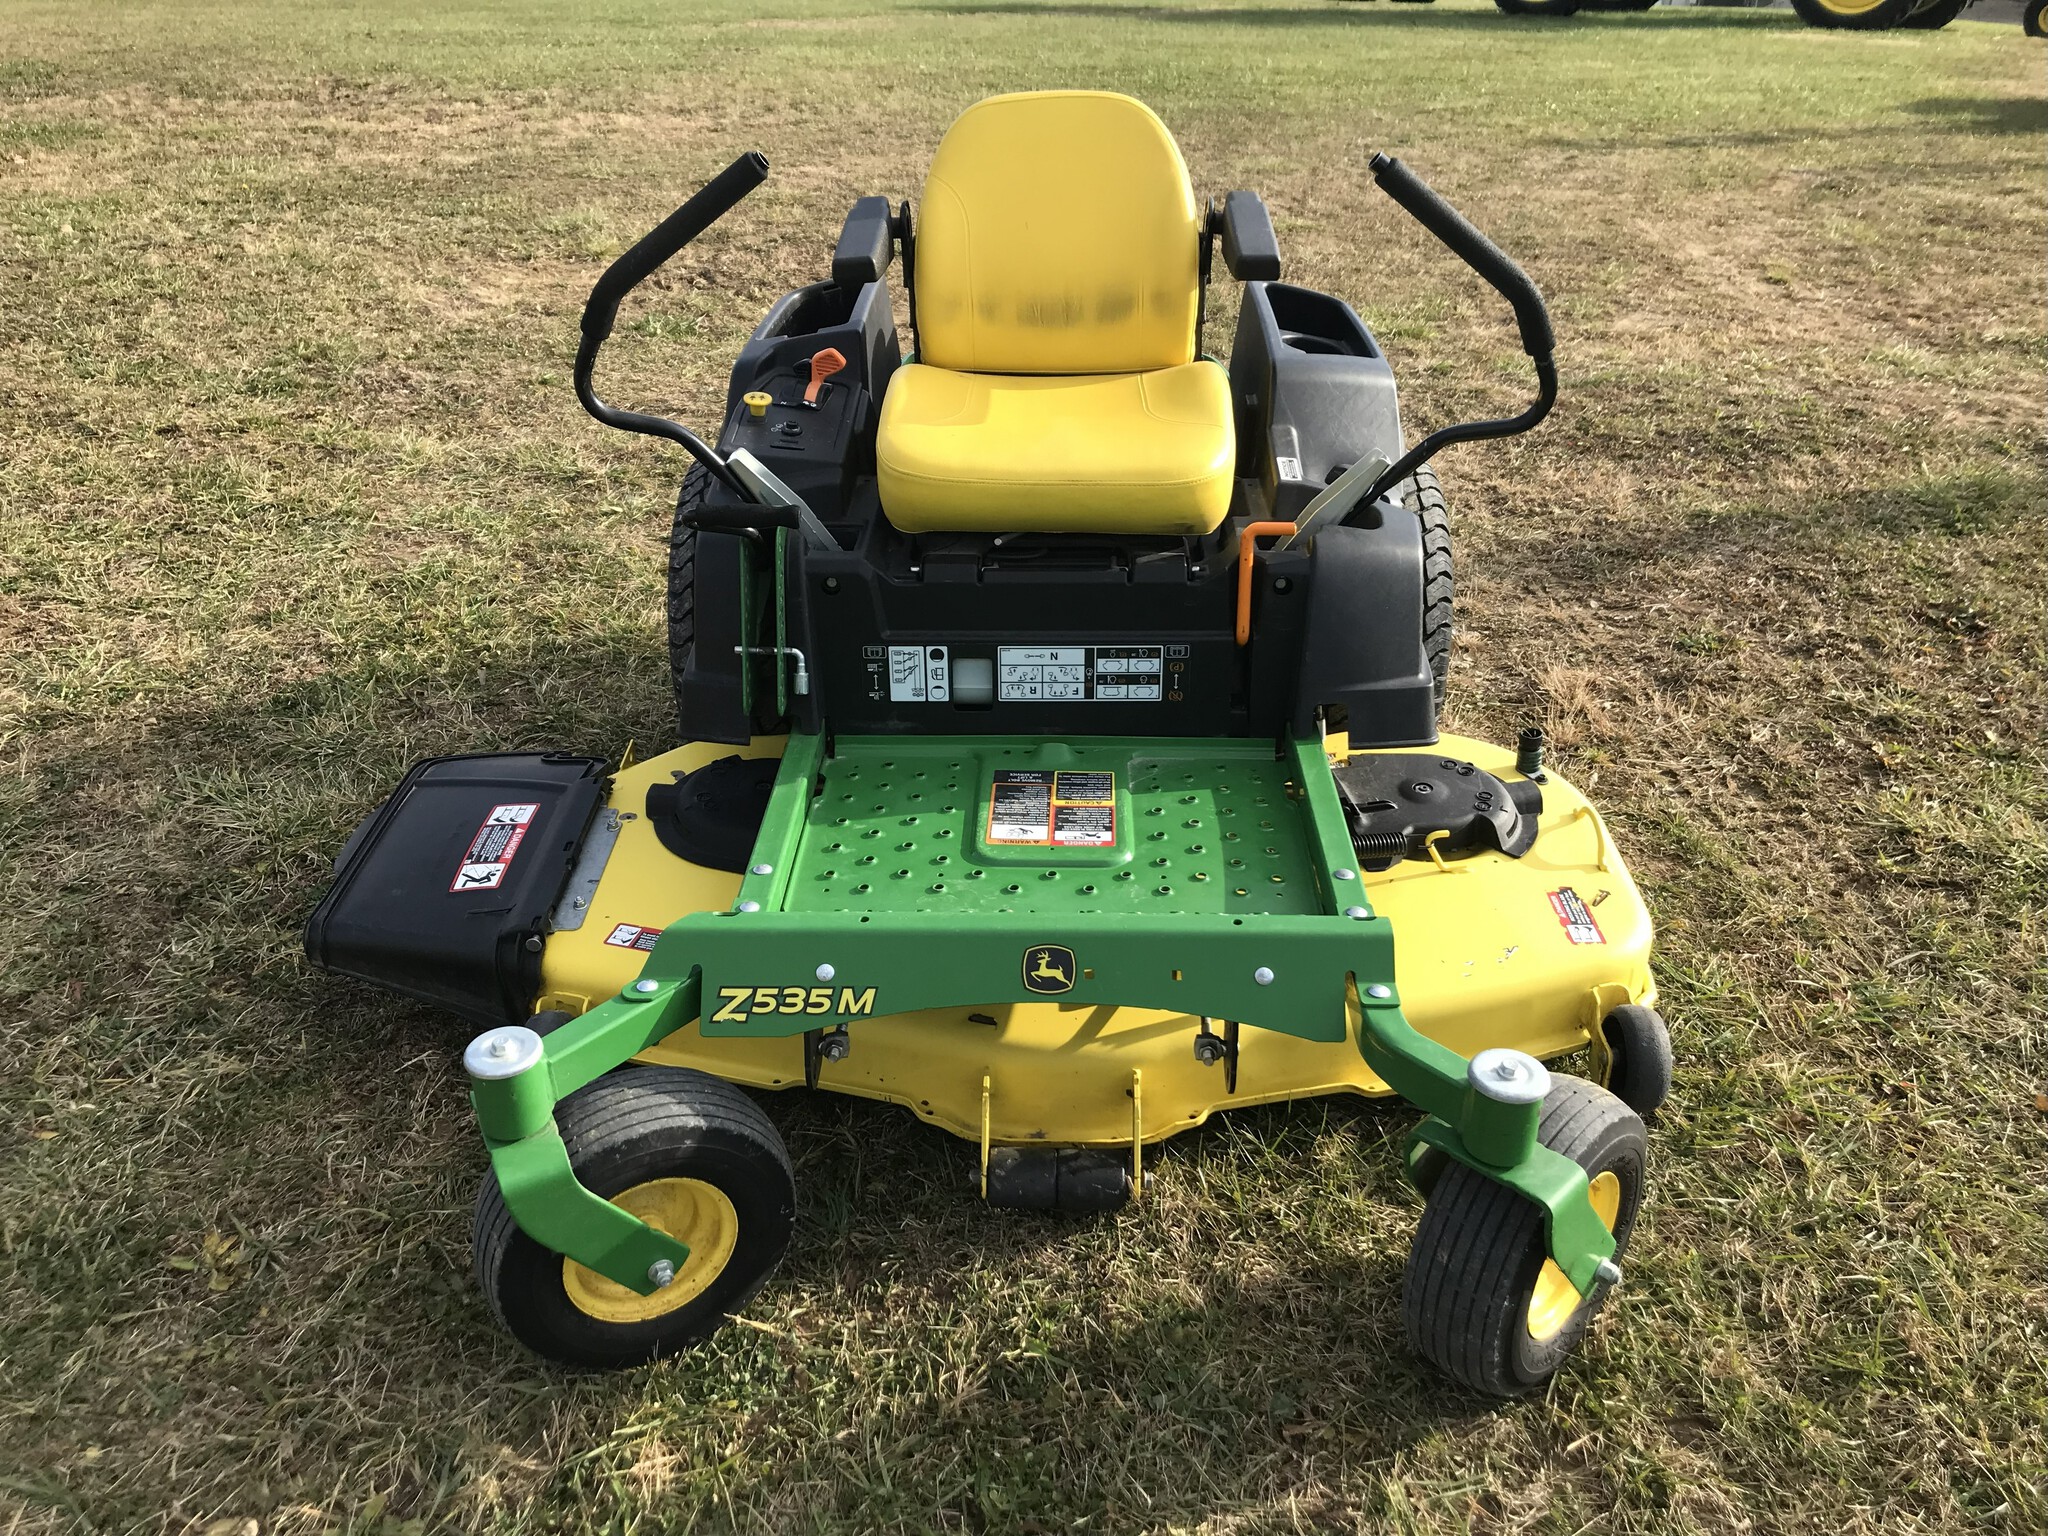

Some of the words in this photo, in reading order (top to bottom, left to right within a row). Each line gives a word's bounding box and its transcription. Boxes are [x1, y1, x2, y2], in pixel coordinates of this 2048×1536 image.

[1050, 652, 1058, 660] N
[1072, 687, 1079, 695] F
[502, 834, 522, 858] DANGER
